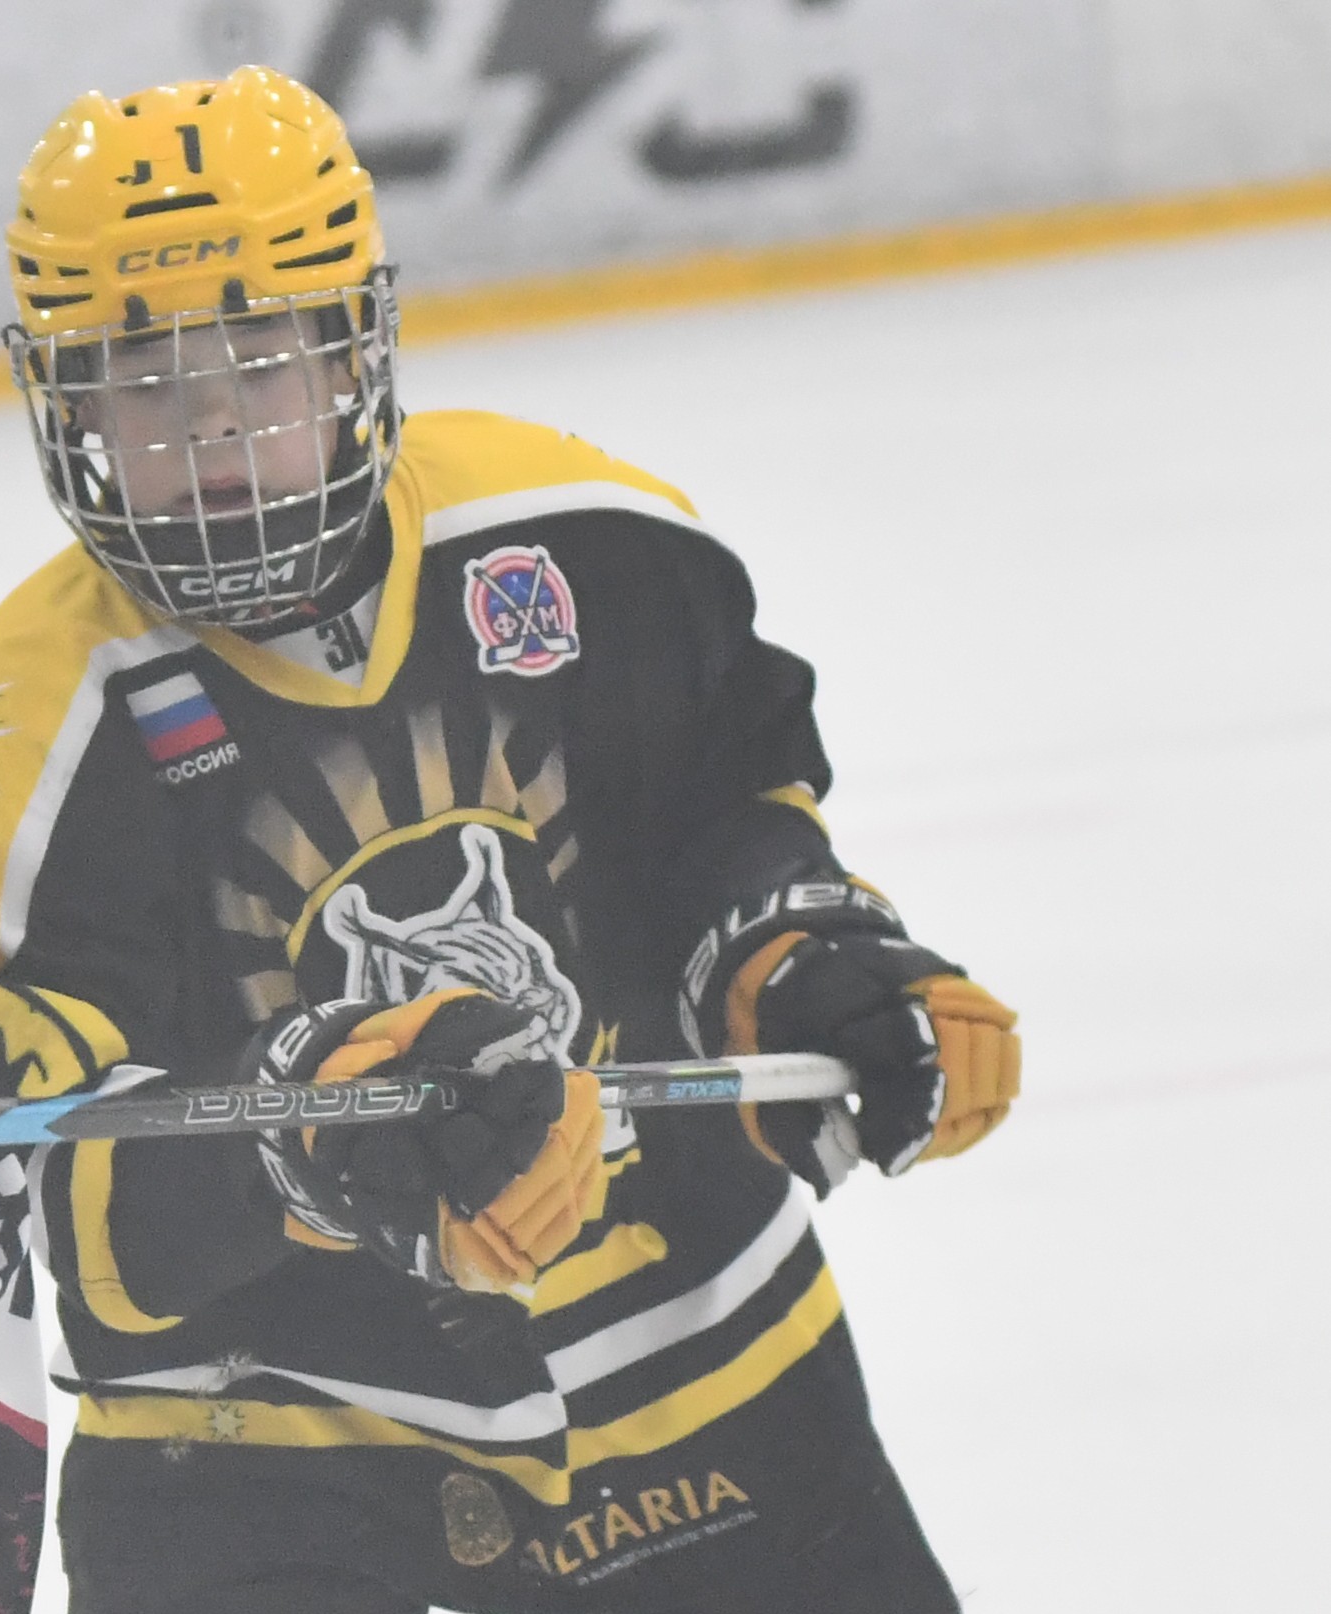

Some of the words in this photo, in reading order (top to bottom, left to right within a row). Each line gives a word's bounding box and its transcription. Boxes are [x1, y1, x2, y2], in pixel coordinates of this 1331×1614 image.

[117, 235, 241, 274] CCM
[181, 560, 296, 596] CCM
[493, 605, 561, 638] ФХМ
